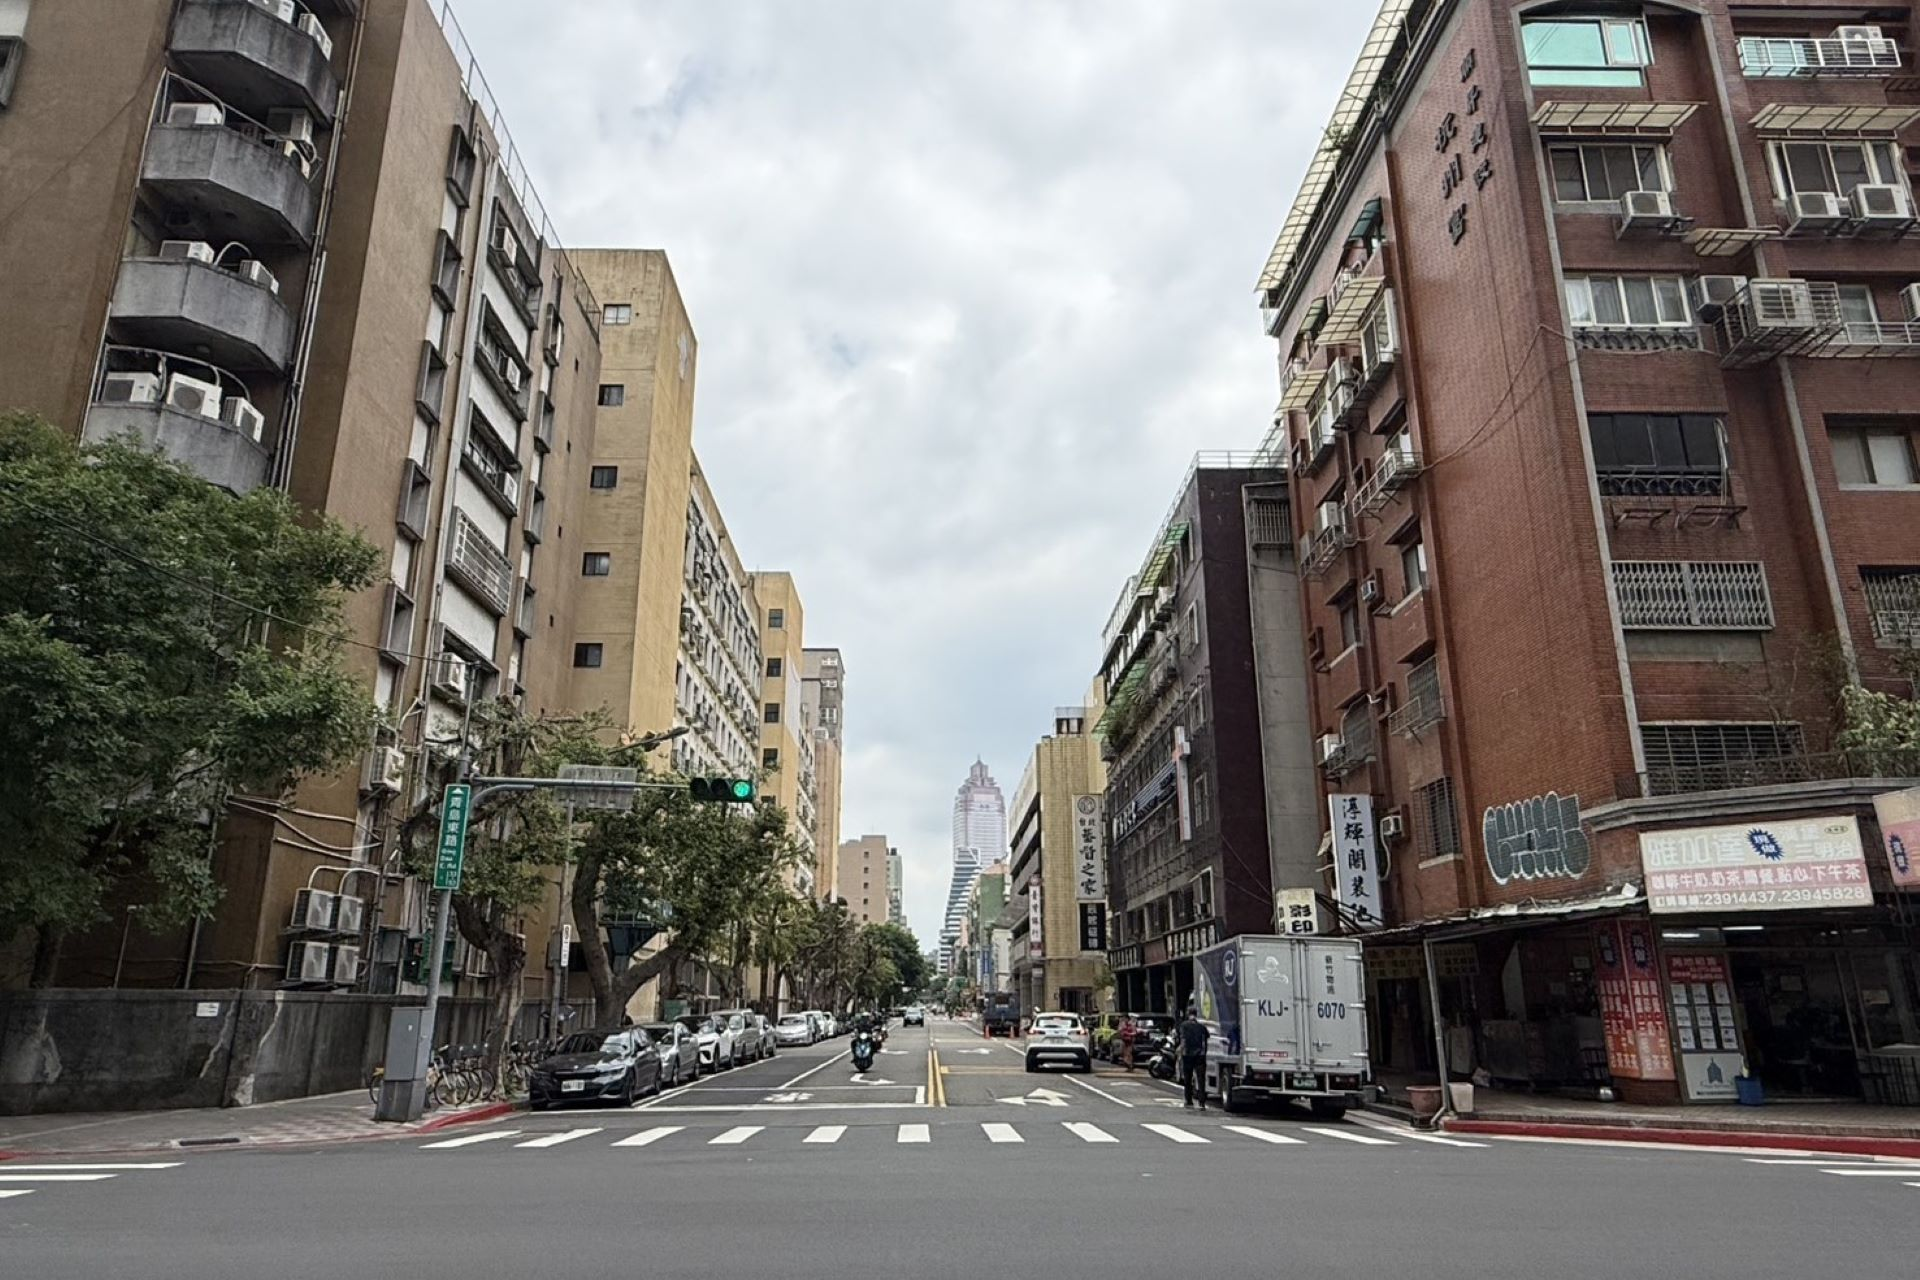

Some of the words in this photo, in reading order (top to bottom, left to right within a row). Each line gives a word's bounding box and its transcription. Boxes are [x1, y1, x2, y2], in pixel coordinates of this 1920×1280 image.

[1079, 828, 1097, 895] 基督之家
[1647, 831, 1746, 867] 雅加達
[1794, 840, 1855, 860] 三明治
[1288, 904, 1314, 933] 影印
[1258, 1000, 1289, 1017] KLJ-
[1317, 1002, 1346, 1020] 6070
